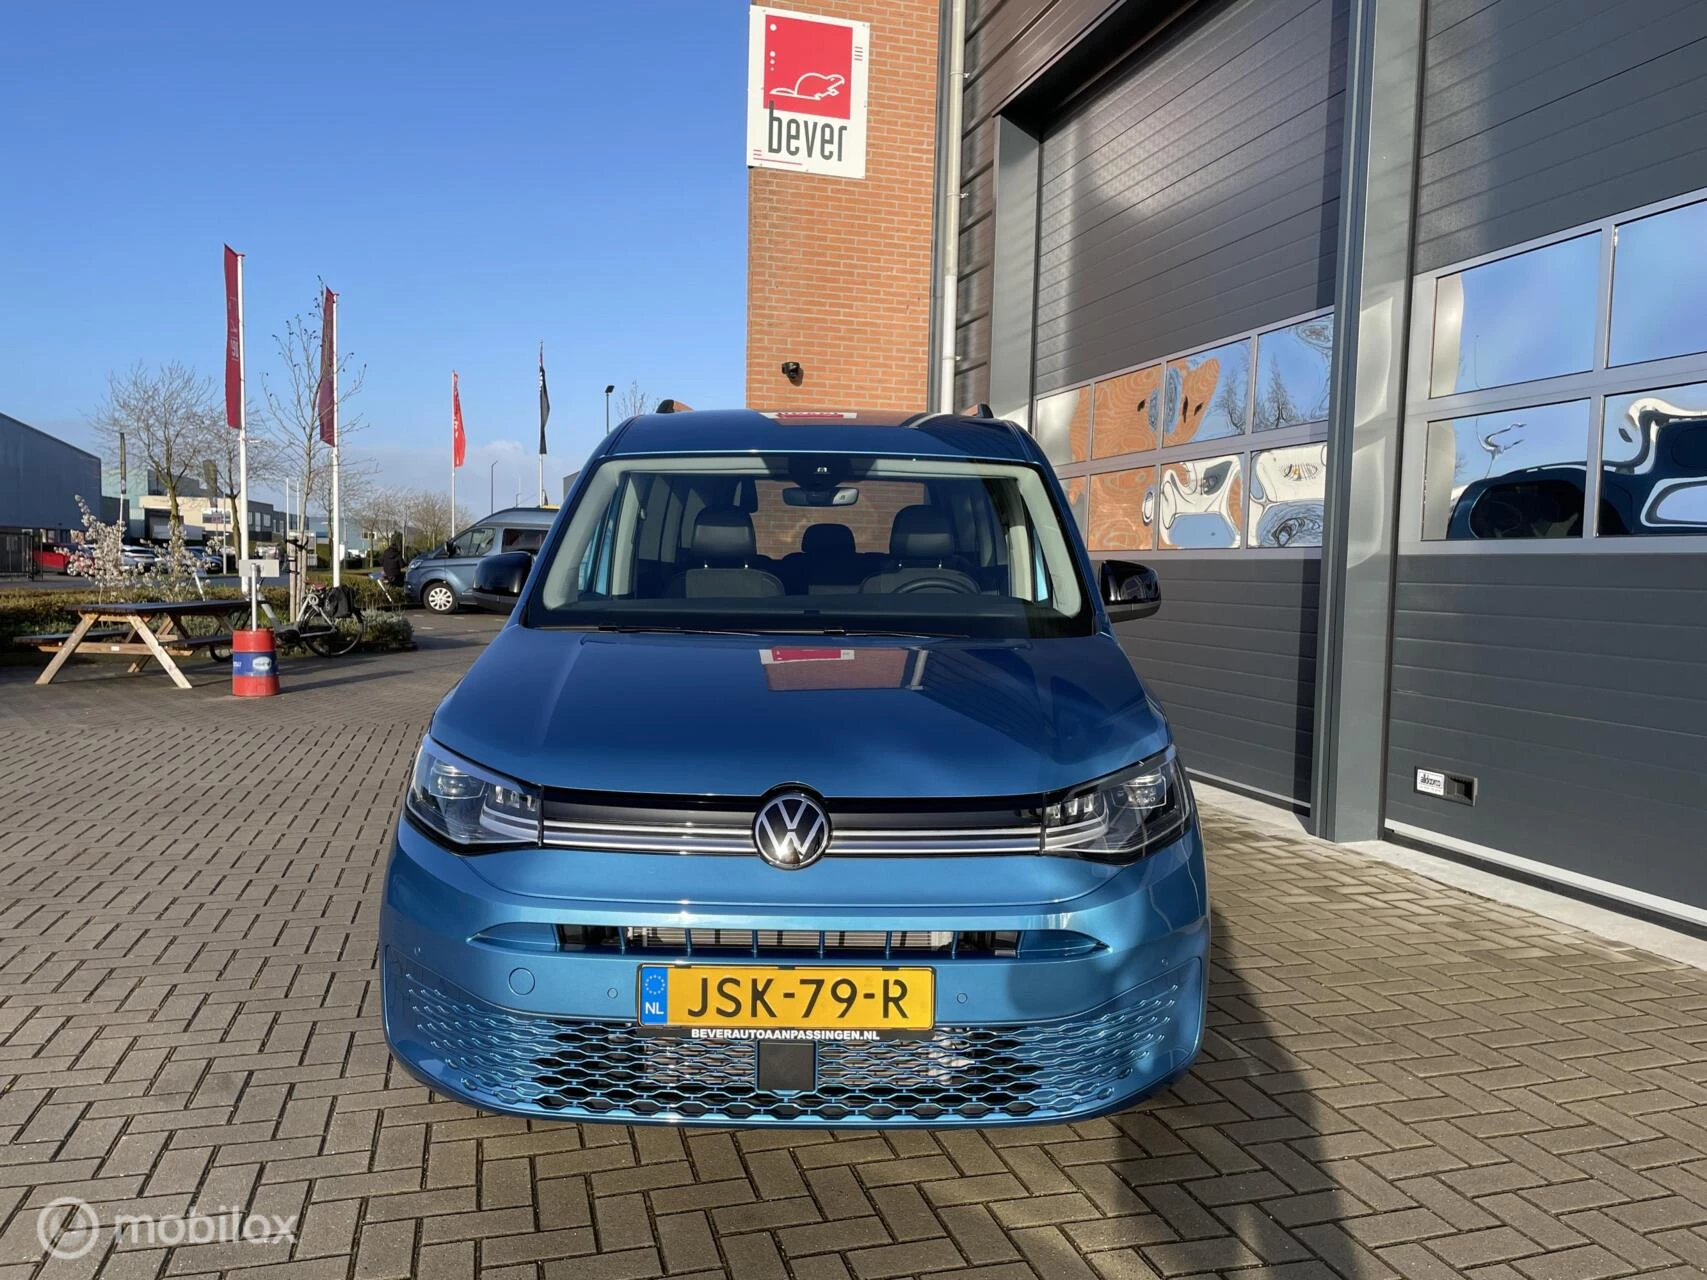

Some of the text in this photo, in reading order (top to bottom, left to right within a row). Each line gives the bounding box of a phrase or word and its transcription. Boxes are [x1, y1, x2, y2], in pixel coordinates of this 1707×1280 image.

[768, 100, 847, 162] bever
[645, 977, 909, 1019] NL JSK-79-R
[691, 1028, 880, 1041] BEVERAUTOAANPASSINGEN.NL
